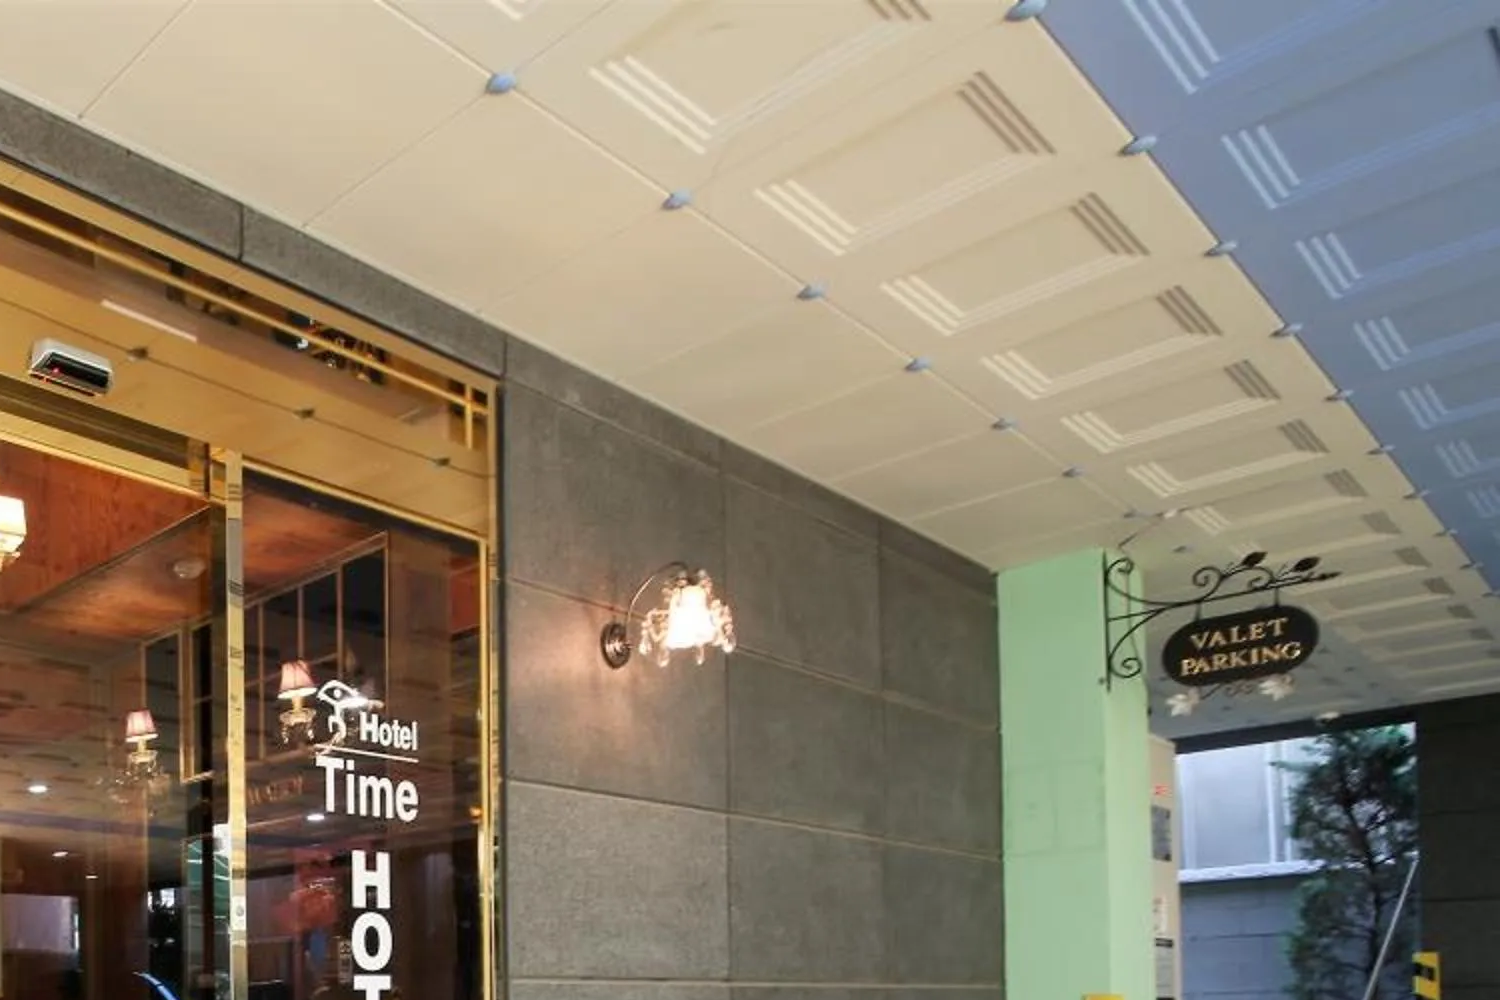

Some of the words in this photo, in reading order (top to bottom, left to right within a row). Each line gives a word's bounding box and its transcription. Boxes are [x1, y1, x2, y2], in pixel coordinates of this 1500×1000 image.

[1190, 617, 1289, 648] VALET
[1180, 641, 1302, 676] PARKING
[359, 711, 418, 751] Hotel
[315, 755, 419, 822] Time
